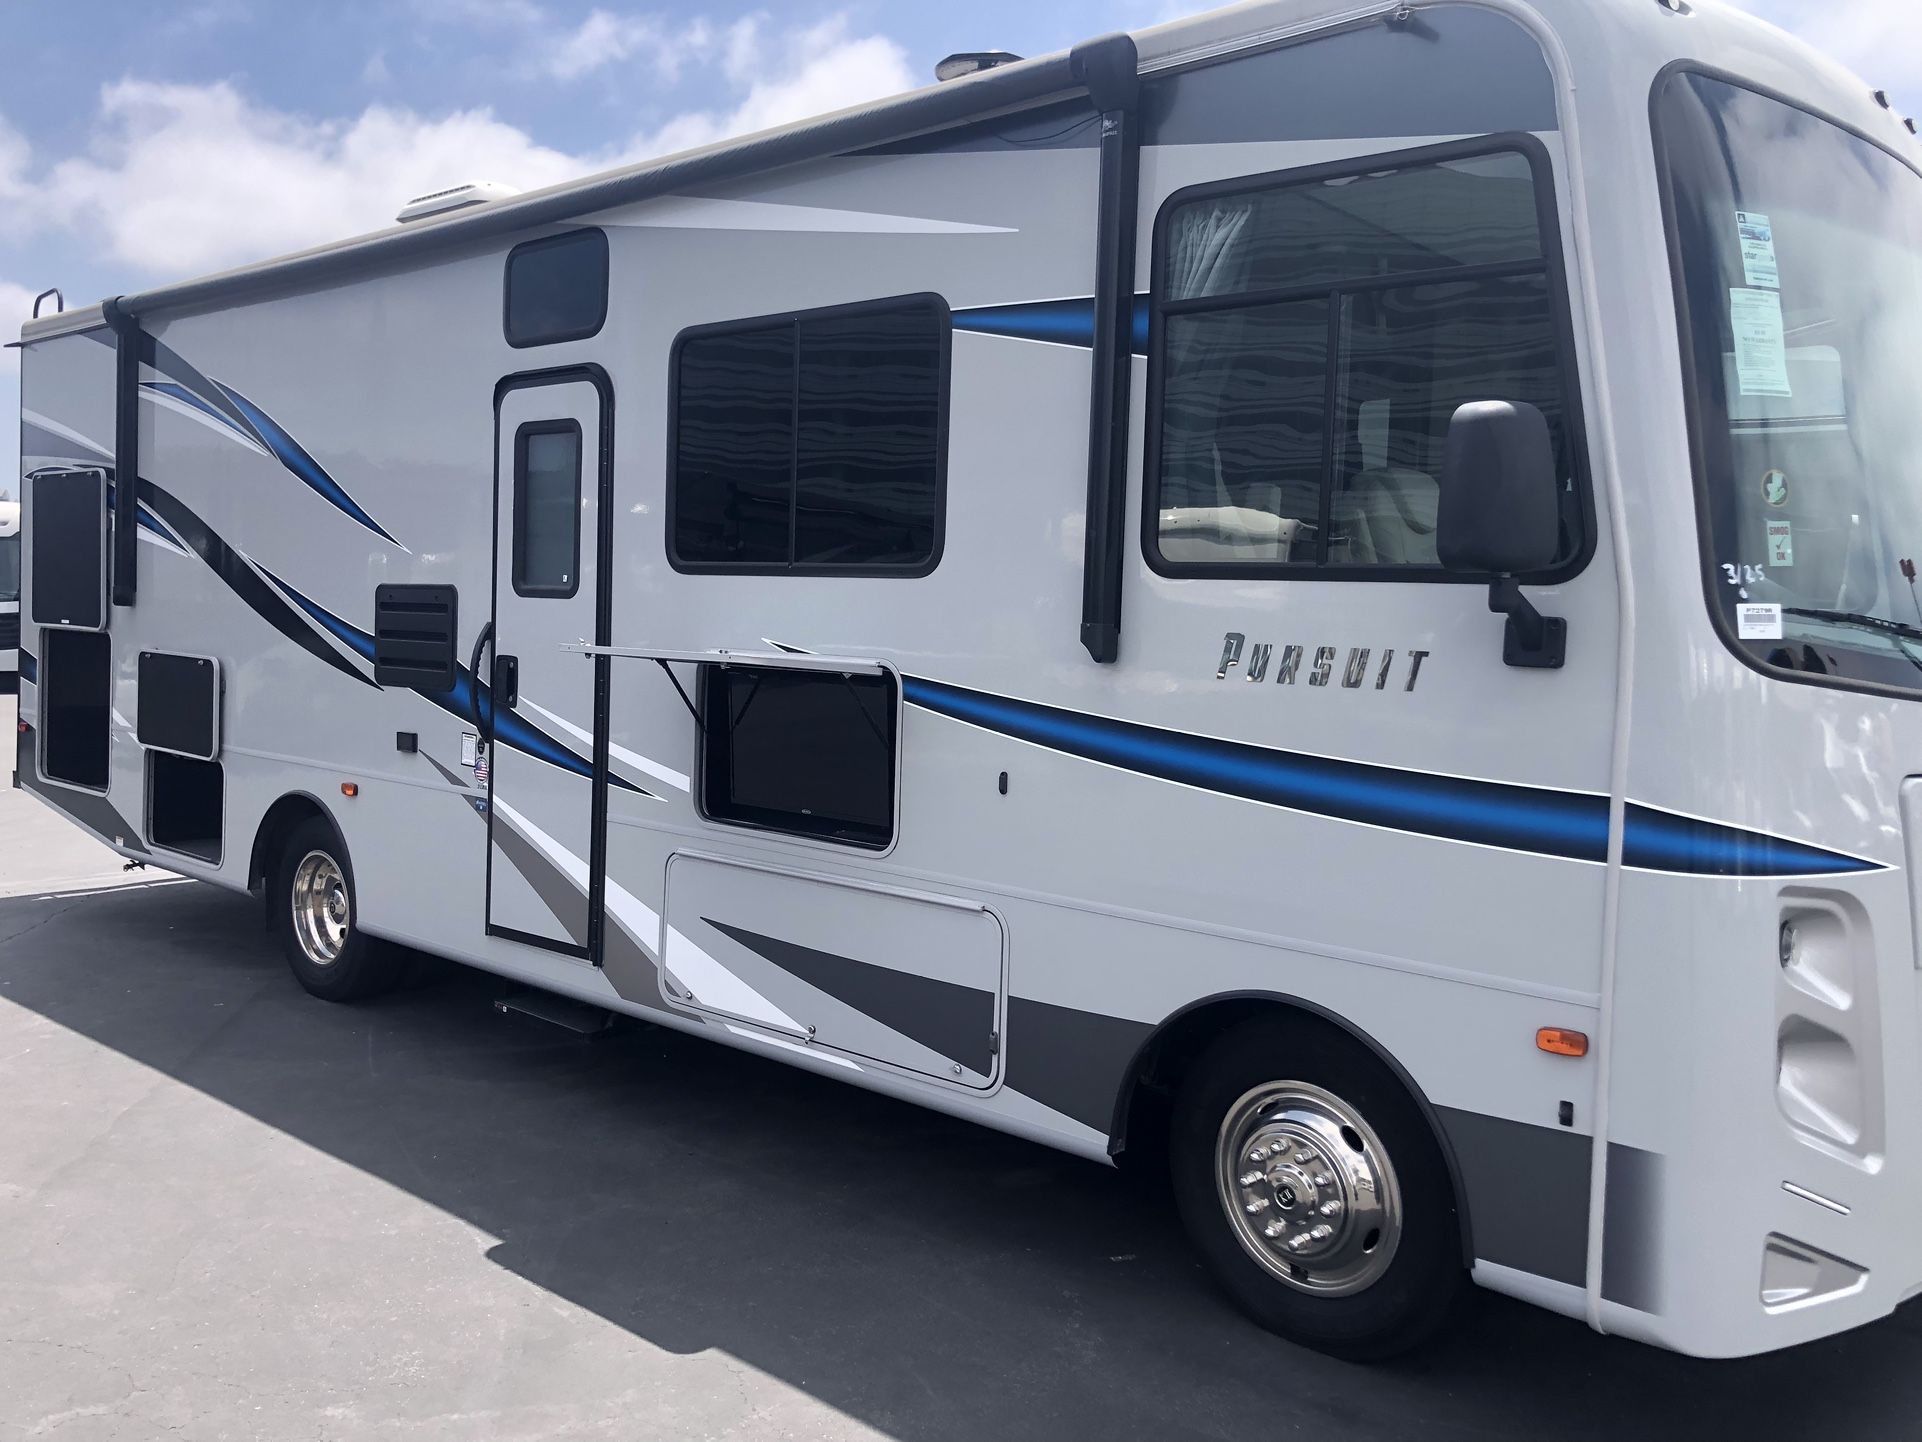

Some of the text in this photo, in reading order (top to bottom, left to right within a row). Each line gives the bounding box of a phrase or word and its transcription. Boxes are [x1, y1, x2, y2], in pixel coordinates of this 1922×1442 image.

[1769, 526, 1789, 535] SMOG
[1776, 552, 1786, 560] OK
[1216, 632, 1430, 692] PURSUIT
